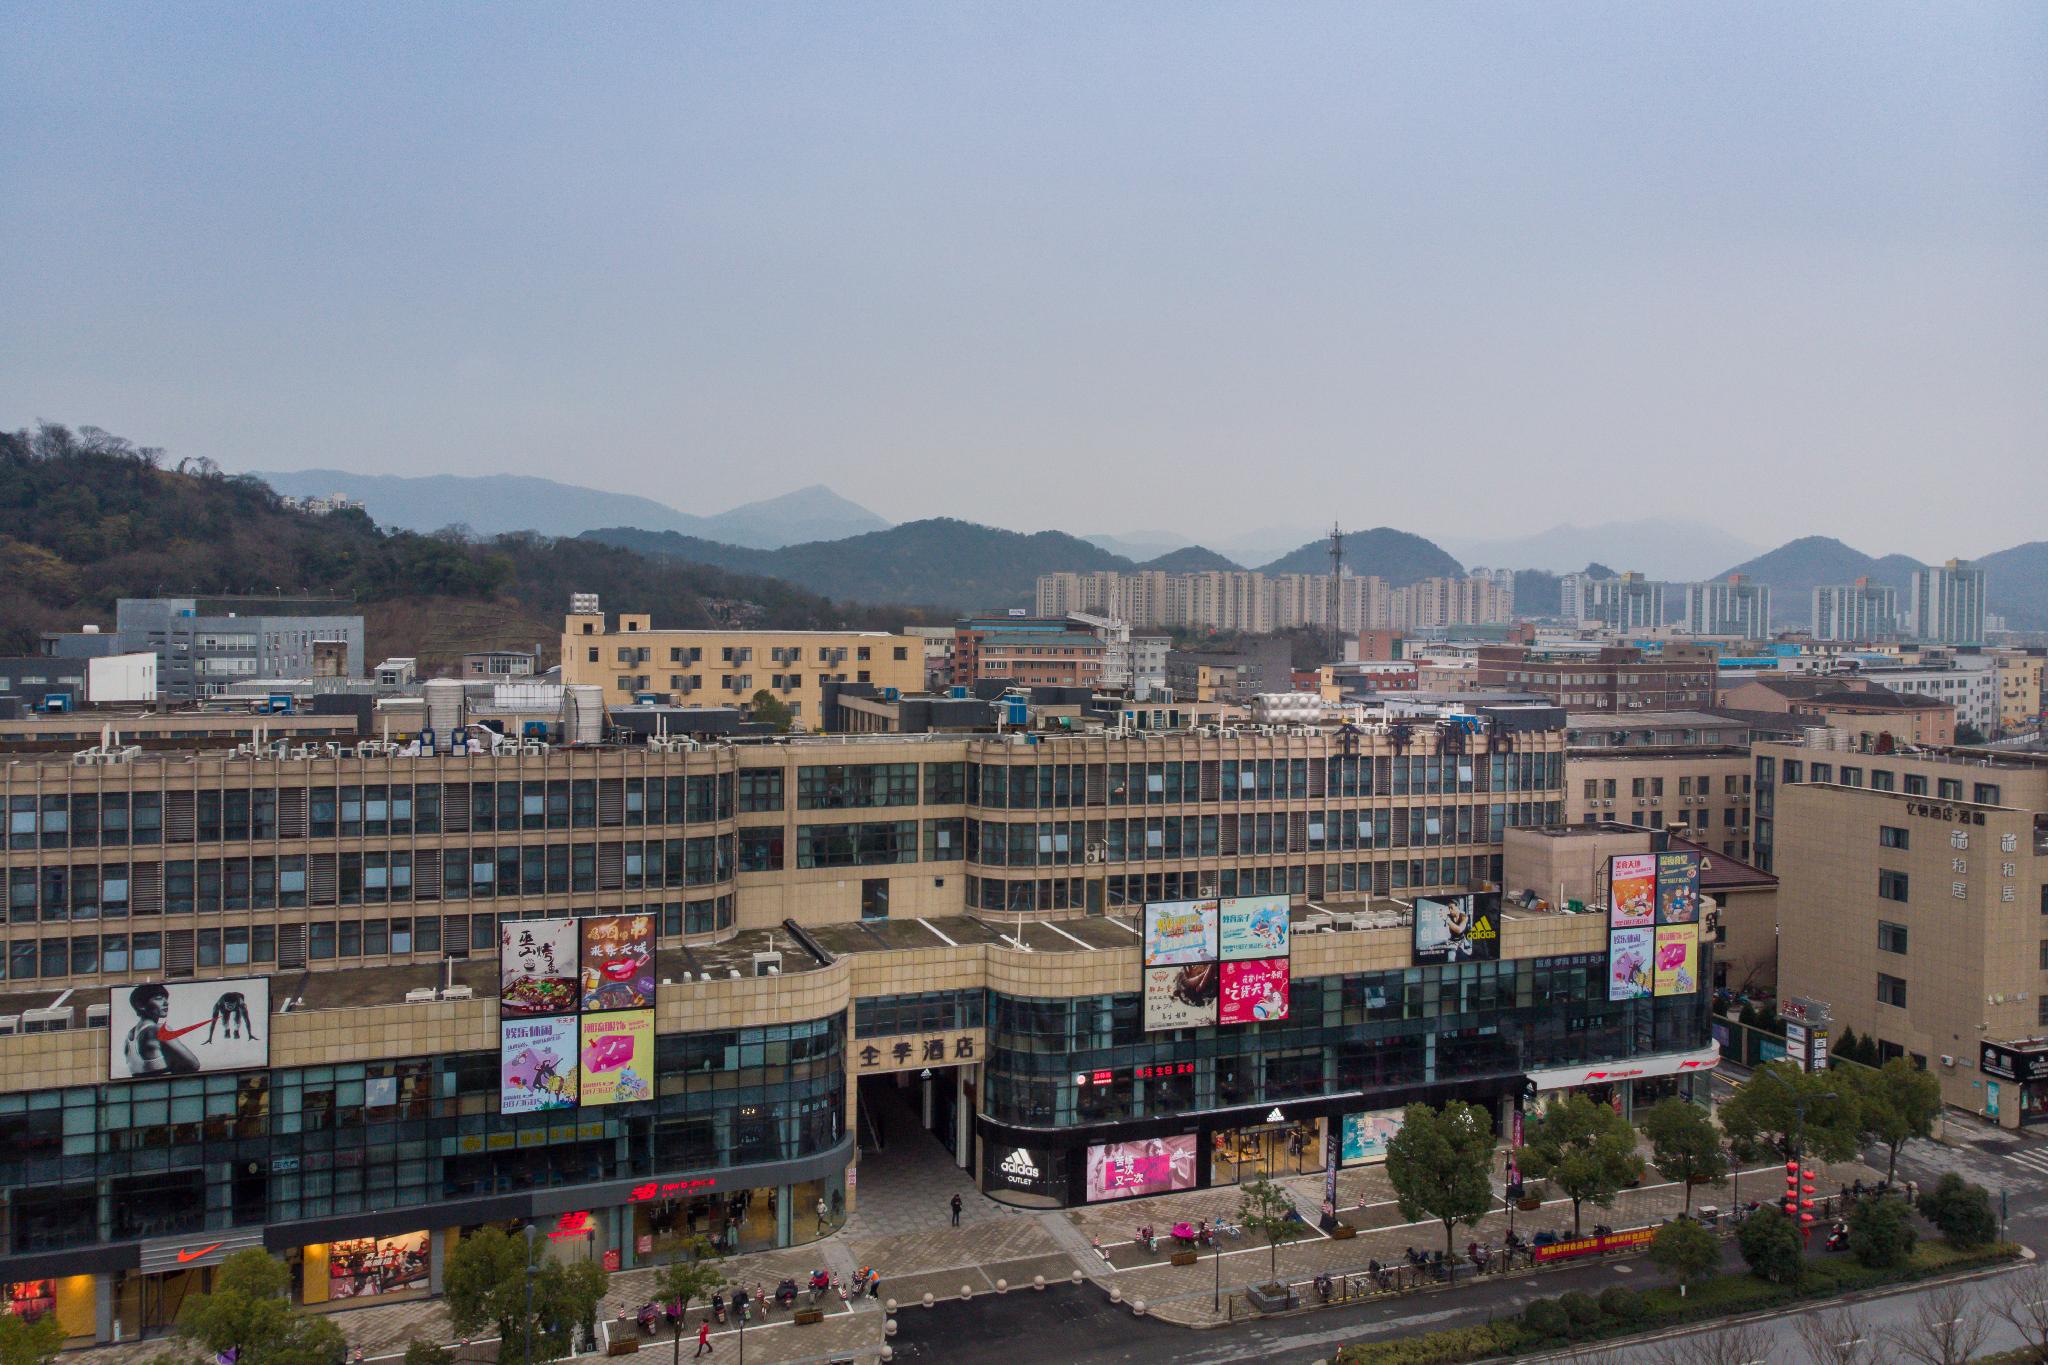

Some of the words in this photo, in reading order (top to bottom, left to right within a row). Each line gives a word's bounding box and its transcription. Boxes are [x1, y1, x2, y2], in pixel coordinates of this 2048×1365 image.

[1467, 929, 1496, 940] adidas
[1225, 981, 1273, 1001] 吃货天堂
[505, 1024, 553, 1039] 娱乐休闲
[859, 1036, 974, 1067] 全季酒店
[1001, 1162, 1039, 1178] adidas
[1115, 1165, 1134, 1175] 一次
[1008, 1175, 1032, 1186] OUTLET
[1115, 1172, 1144, 1186] 又一次
